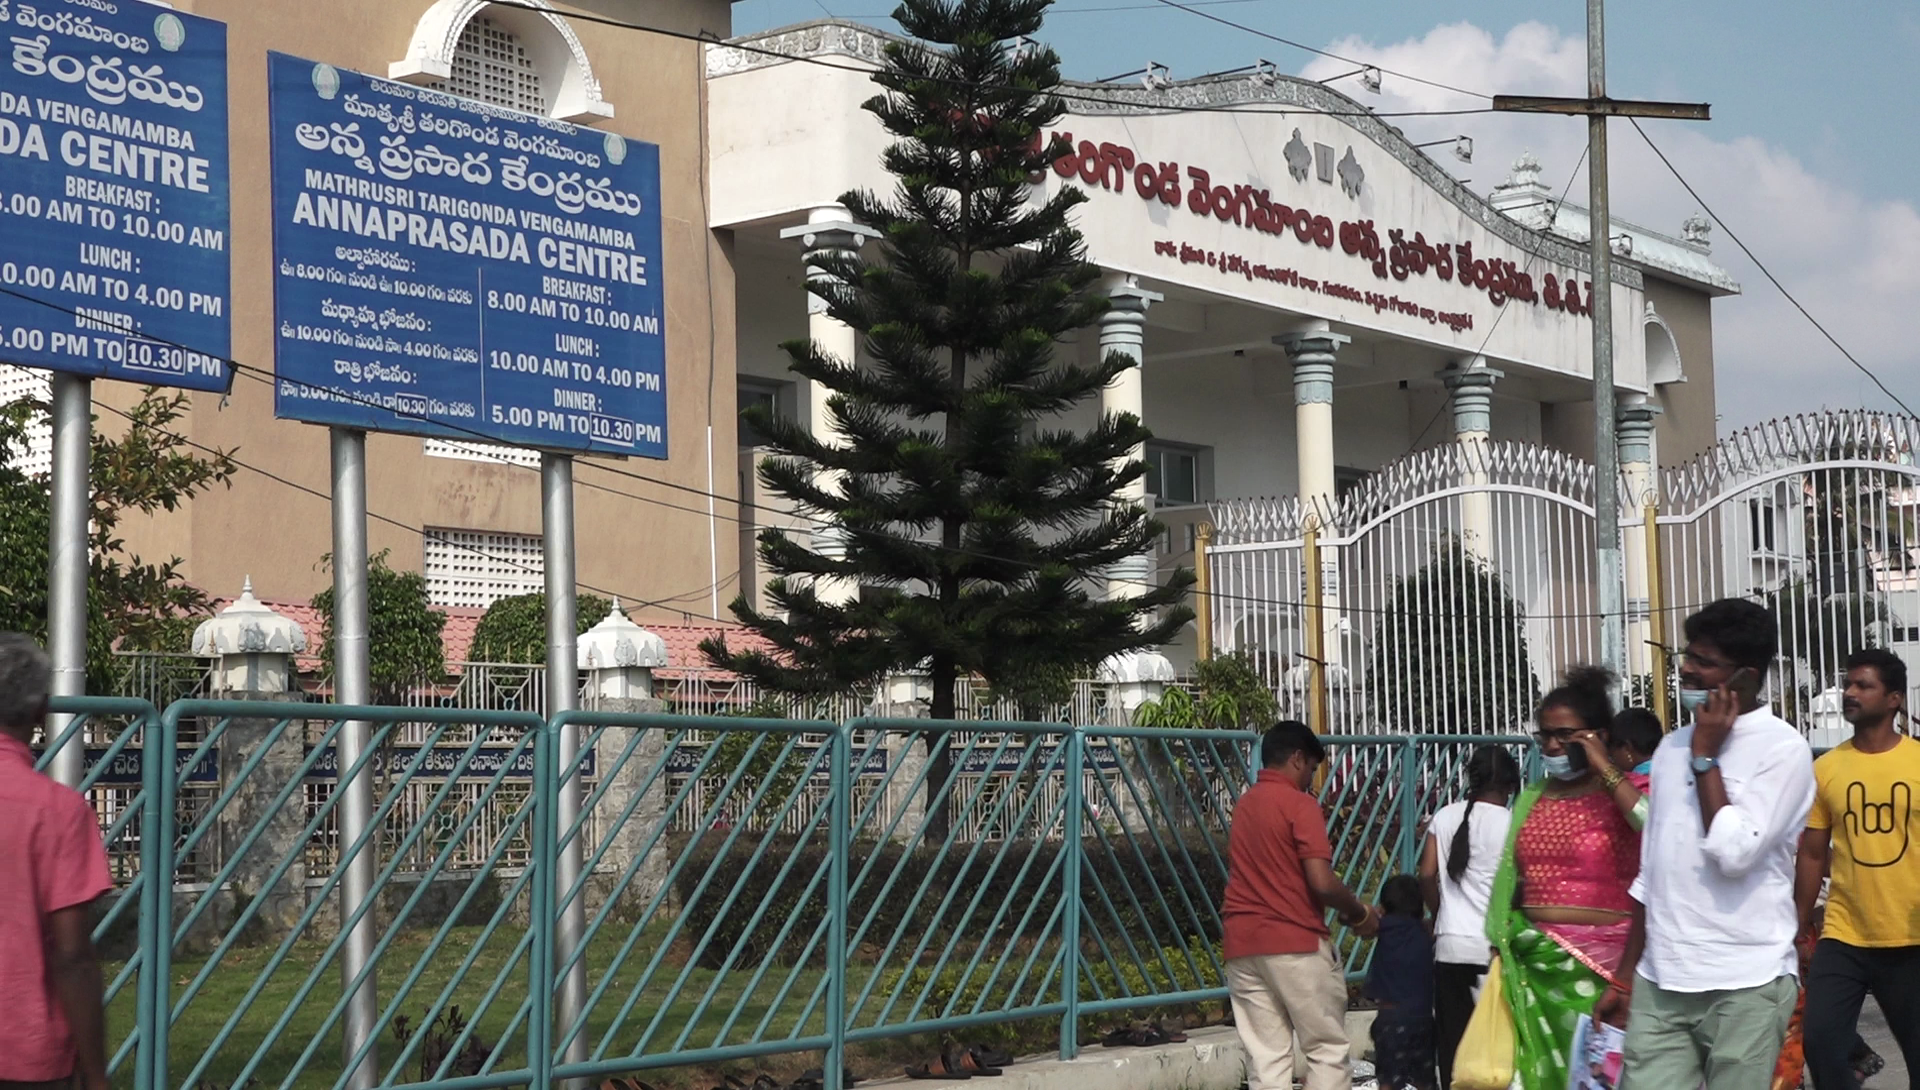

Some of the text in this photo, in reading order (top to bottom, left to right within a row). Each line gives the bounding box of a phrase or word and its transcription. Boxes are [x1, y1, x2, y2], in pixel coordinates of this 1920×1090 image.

[16, 4, 150, 54] వెంగమాంబ
[10, 35, 204, 112] కేంద్రము
[36, 98, 195, 151] VENGAMAMBA
[418, 112, 499, 147] తరిగొండ
[503, 129, 601, 168] వెంగమాంబ
[60, 131, 209, 193] CENTRE
[295, 122, 642, 216] అన్న ప్రసాద కేంద్రము
[0, 192, 223, 251] .00 AM TO 10.00 AM
[305, 168, 635, 250] MATHRUSRI TARIGONDA VENGAMAMBA
[292, 192, 647, 286] ANNAPRASADA CENTRE
[60, 271, 96, 296] AM
[102, 277, 129, 301] TO
[135, 284, 183, 310] 4.00
[190, 292, 222, 317] PM
[296, 264, 325, 281] 8.00
[394, 280, 426, 298] 10.00
[487, 290, 658, 335] 8.00 AM TO 10.00 AM
[0, 325, 221, 378] .00 PM TO 10.30 PM
[297, 324, 331, 343] 10.00
[403, 341, 431, 358] 4.00
[490, 350, 660, 392] 10.00 AM TO 4.00 PM
[300, 383, 329, 401] 5.00
[397, 397, 426, 415] 10.30
[492, 404, 661, 443] 5.00 PM TO 10.30 PM
